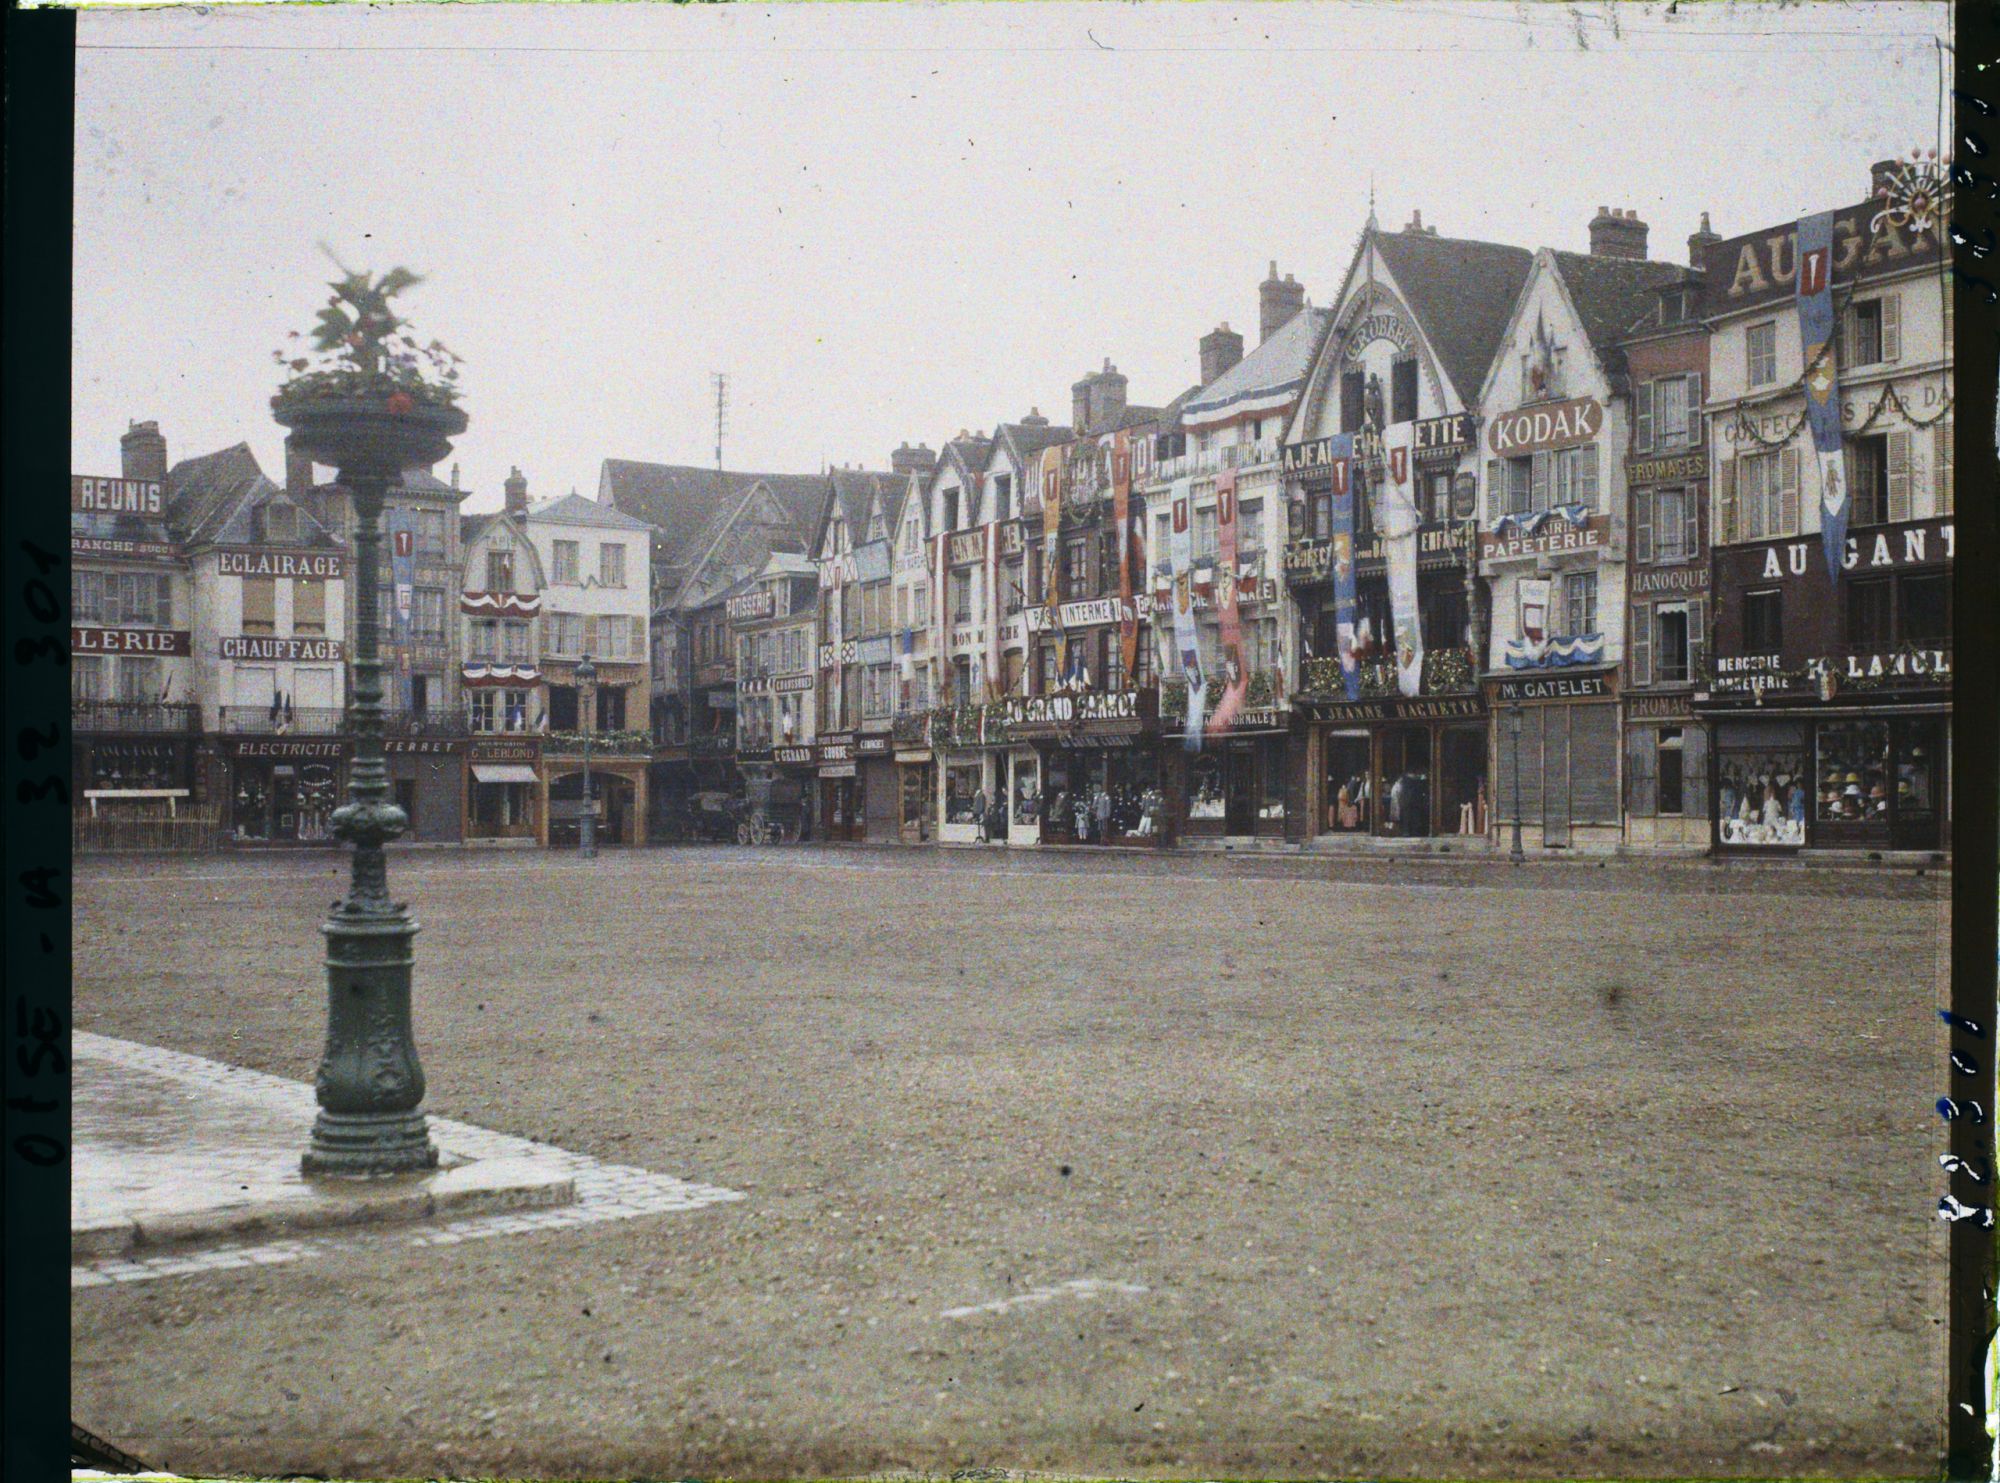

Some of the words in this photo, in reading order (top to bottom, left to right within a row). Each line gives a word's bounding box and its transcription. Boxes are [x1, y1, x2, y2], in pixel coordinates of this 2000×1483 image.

[1727, 232, 1799, 296] AU
[1496, 403, 1593, 450] KODAK
[1628, 456, 1704, 481] FROMAGES
[81, 478, 162, 513] REUNIS
[1483, 529, 1599, 559] PAPETERIE
[220, 552, 340, 577] ECLAIRAGE
[1762, 543, 1809, 578] AU
[1632, 568, 1709, 593] HANOCQUE
[223, 638, 340, 659] CHAUFFAGE
[1524, 678, 1603, 698] GATELET
[1026, 696, 1073, 722] GRAND
[1328, 704, 1384, 721] JEANNE
[1396, 701, 1481, 720] HACHETTE
[238, 742, 342, 757] ELECTRICITE
[384, 741, 455, 753] FERRET
